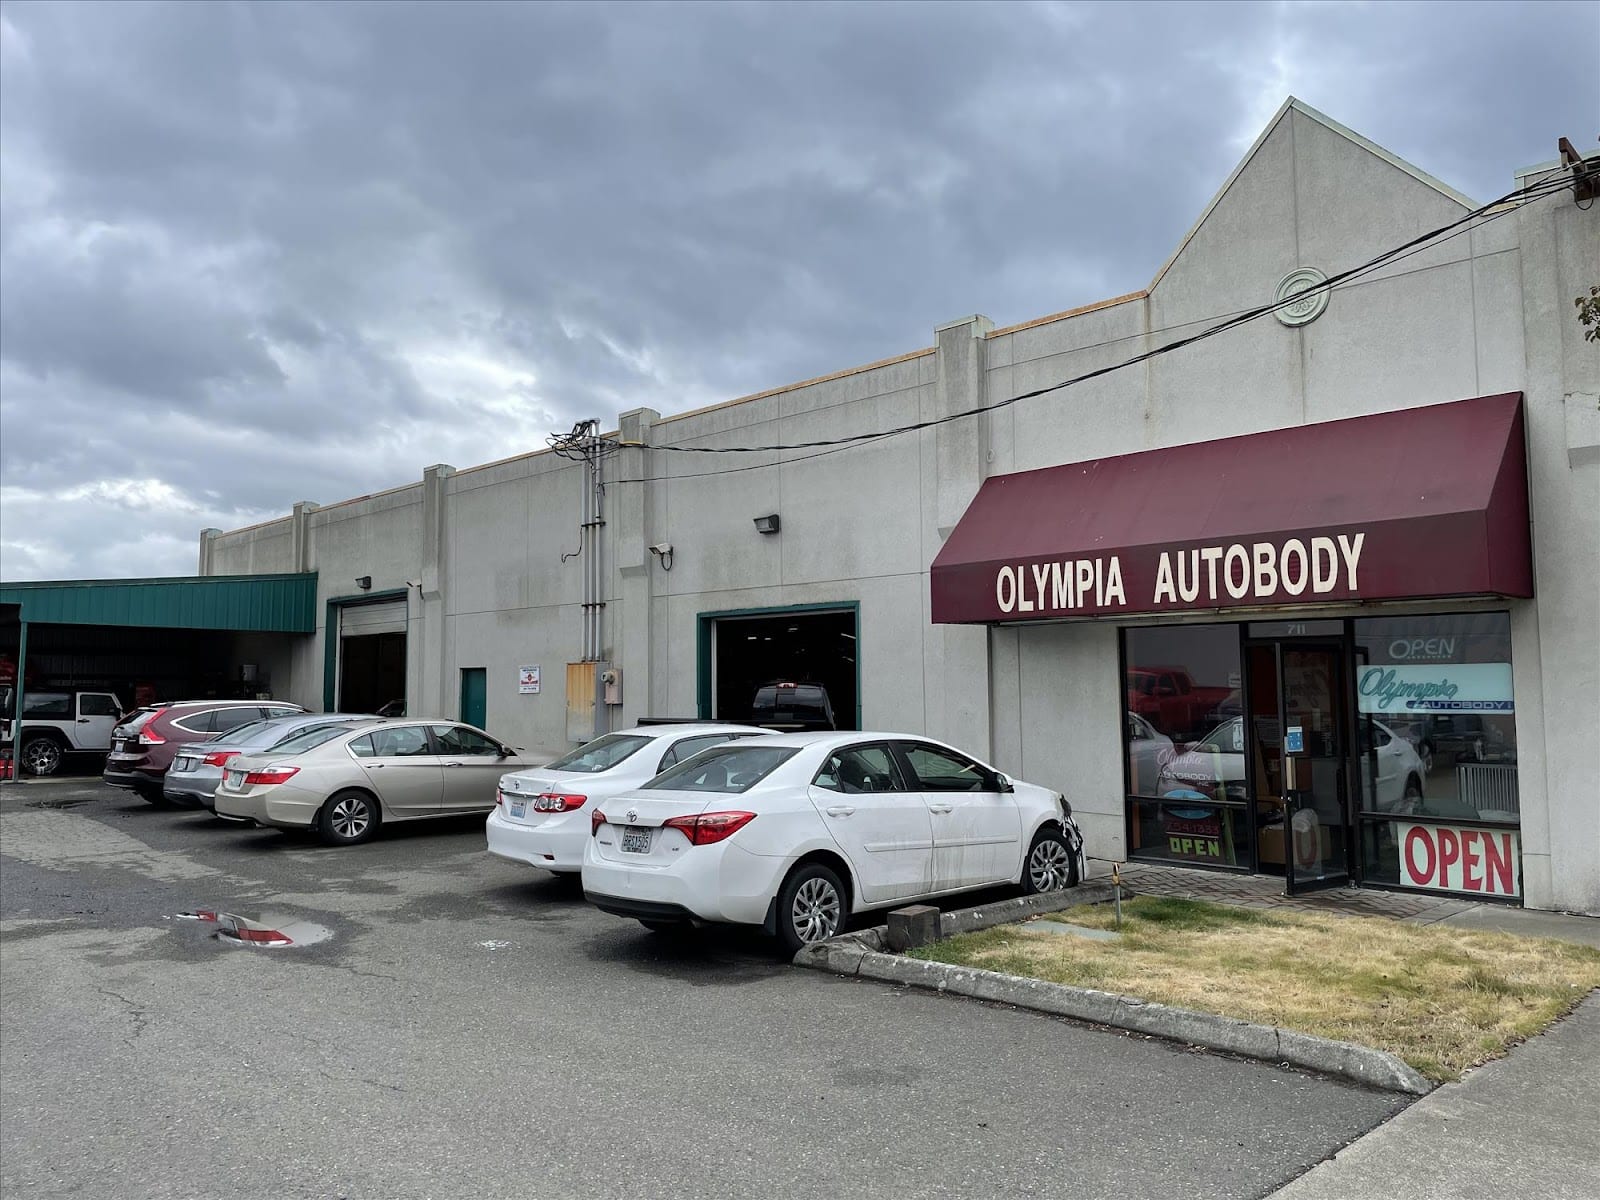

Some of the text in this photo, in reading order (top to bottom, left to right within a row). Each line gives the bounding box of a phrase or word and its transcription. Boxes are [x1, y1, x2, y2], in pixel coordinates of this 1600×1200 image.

[996, 533, 1365, 613] OLYMPIA AUTOBODY
[1287, 624, 1306, 635] 711
[1389, 638, 1455, 659] OPEN
[1422, 701, 1505, 710] AUTOBODY
[1169, 838, 1220, 857] OPEN
[1404, 826, 1514, 894] OPEN
